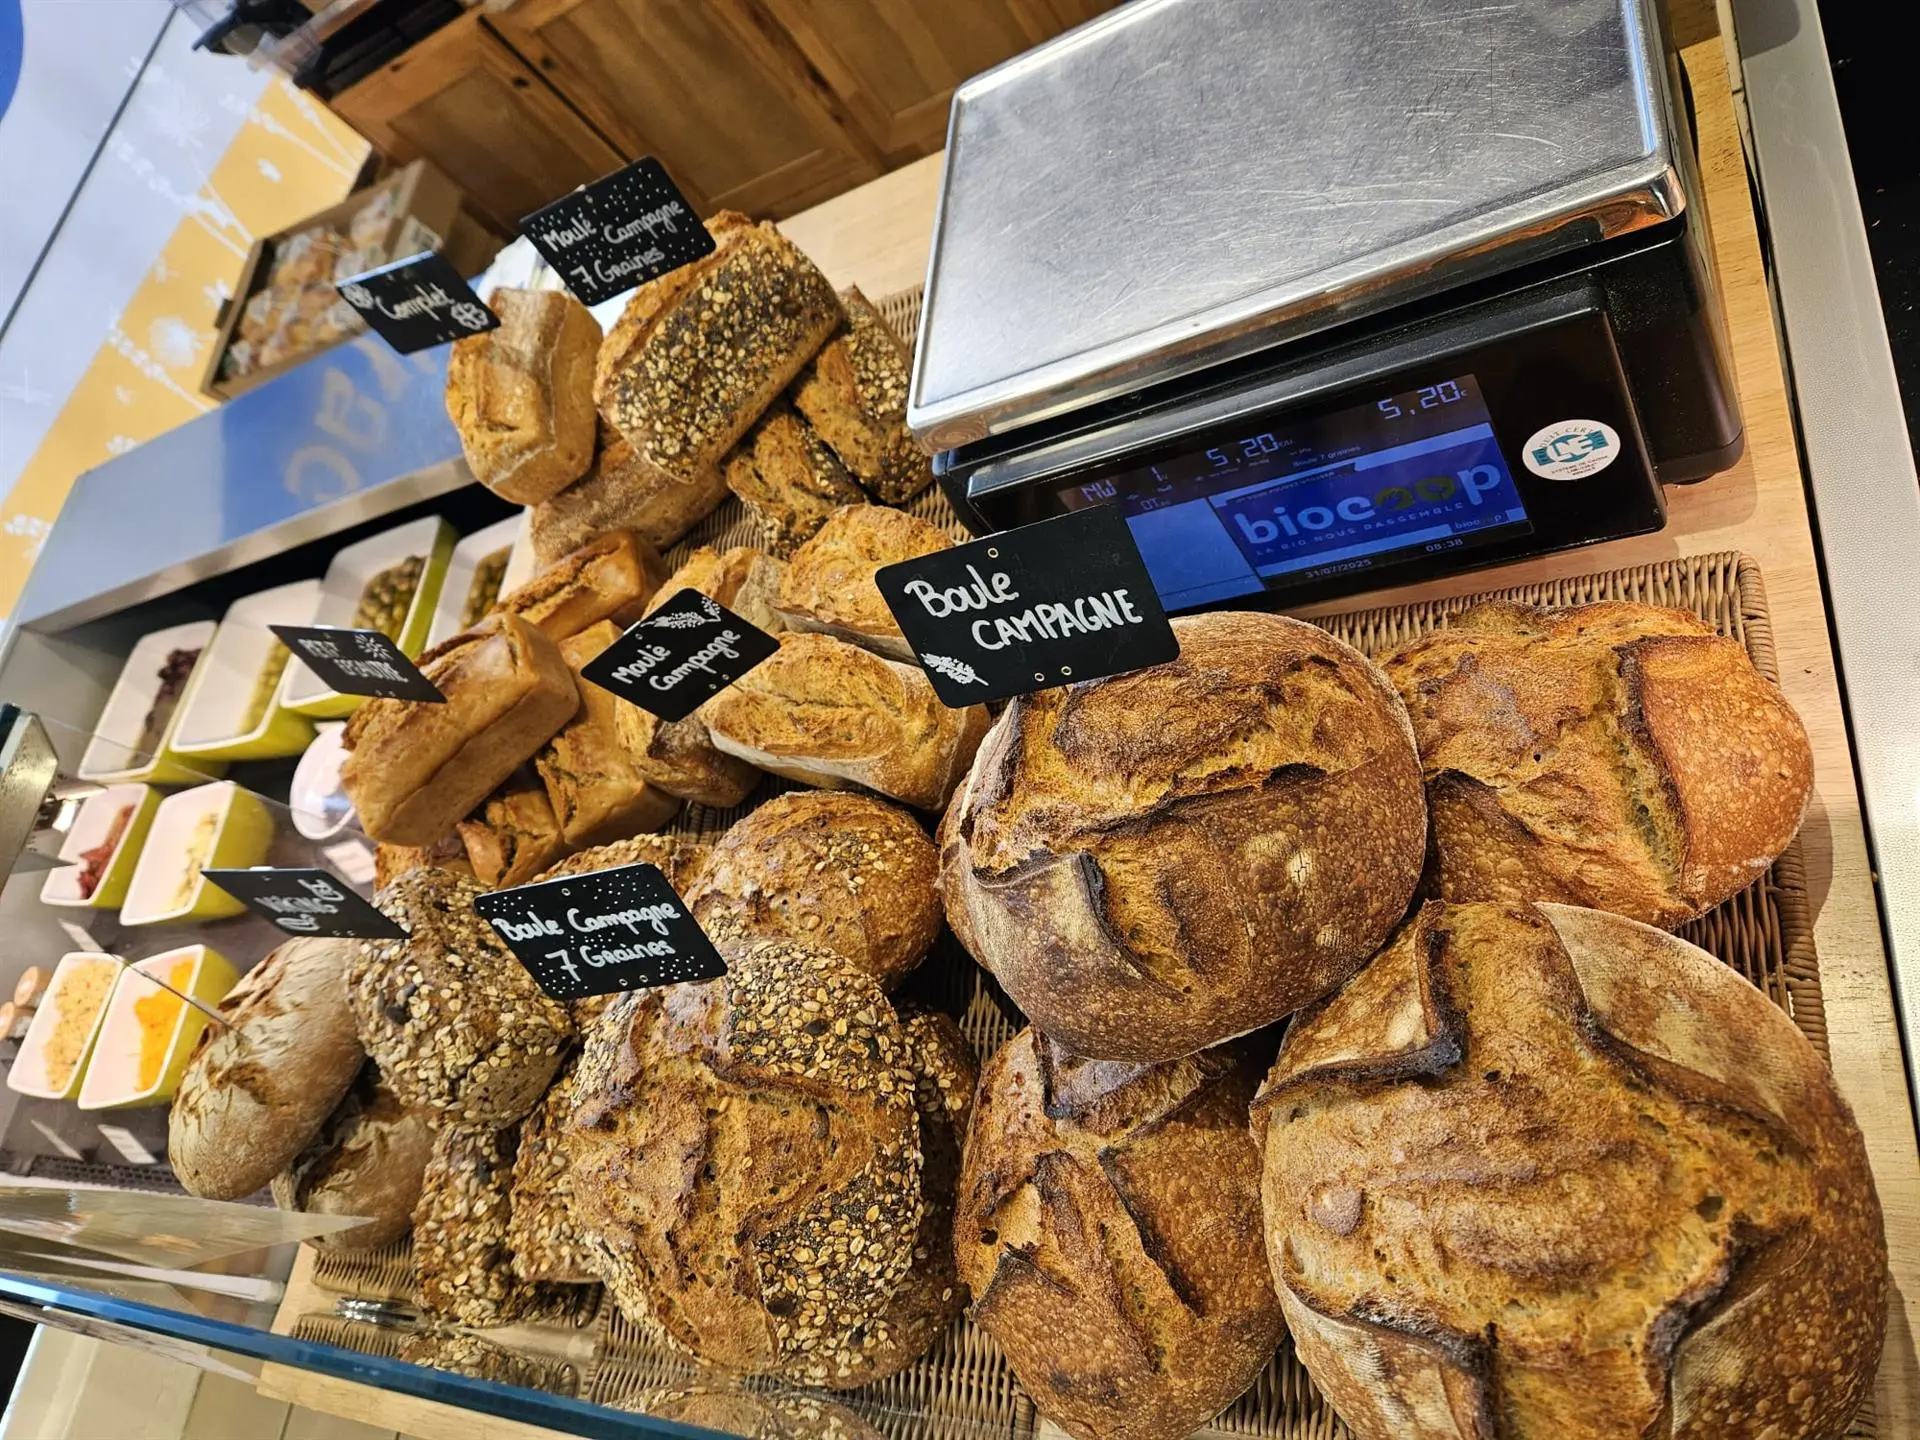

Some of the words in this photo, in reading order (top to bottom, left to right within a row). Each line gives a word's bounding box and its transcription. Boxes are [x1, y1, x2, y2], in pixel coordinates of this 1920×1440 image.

[543, 212, 597, 253] Moulé
[603, 200, 684, 244] Campagne
[570, 264, 598, 290] 7
[594, 246, 665, 283] Graines
[374, 281, 456, 321] Complet
[1234, 464, 1501, 544] biocoop
[1313, 527, 1357, 543] NOUS
[1304, 557, 1373, 579] 31/07/2025
[903, 564, 1019, 619] Boule
[971, 588, 1144, 651] CAMPAGNE
[611, 644, 671, 685] Moulé
[649, 629, 741, 691] Campagne
[491, 911, 565, 942] Boule
[566, 902, 682, 936] Campagne
[545, 949, 582, 982] 7
[580, 938, 677, 968] Graines
